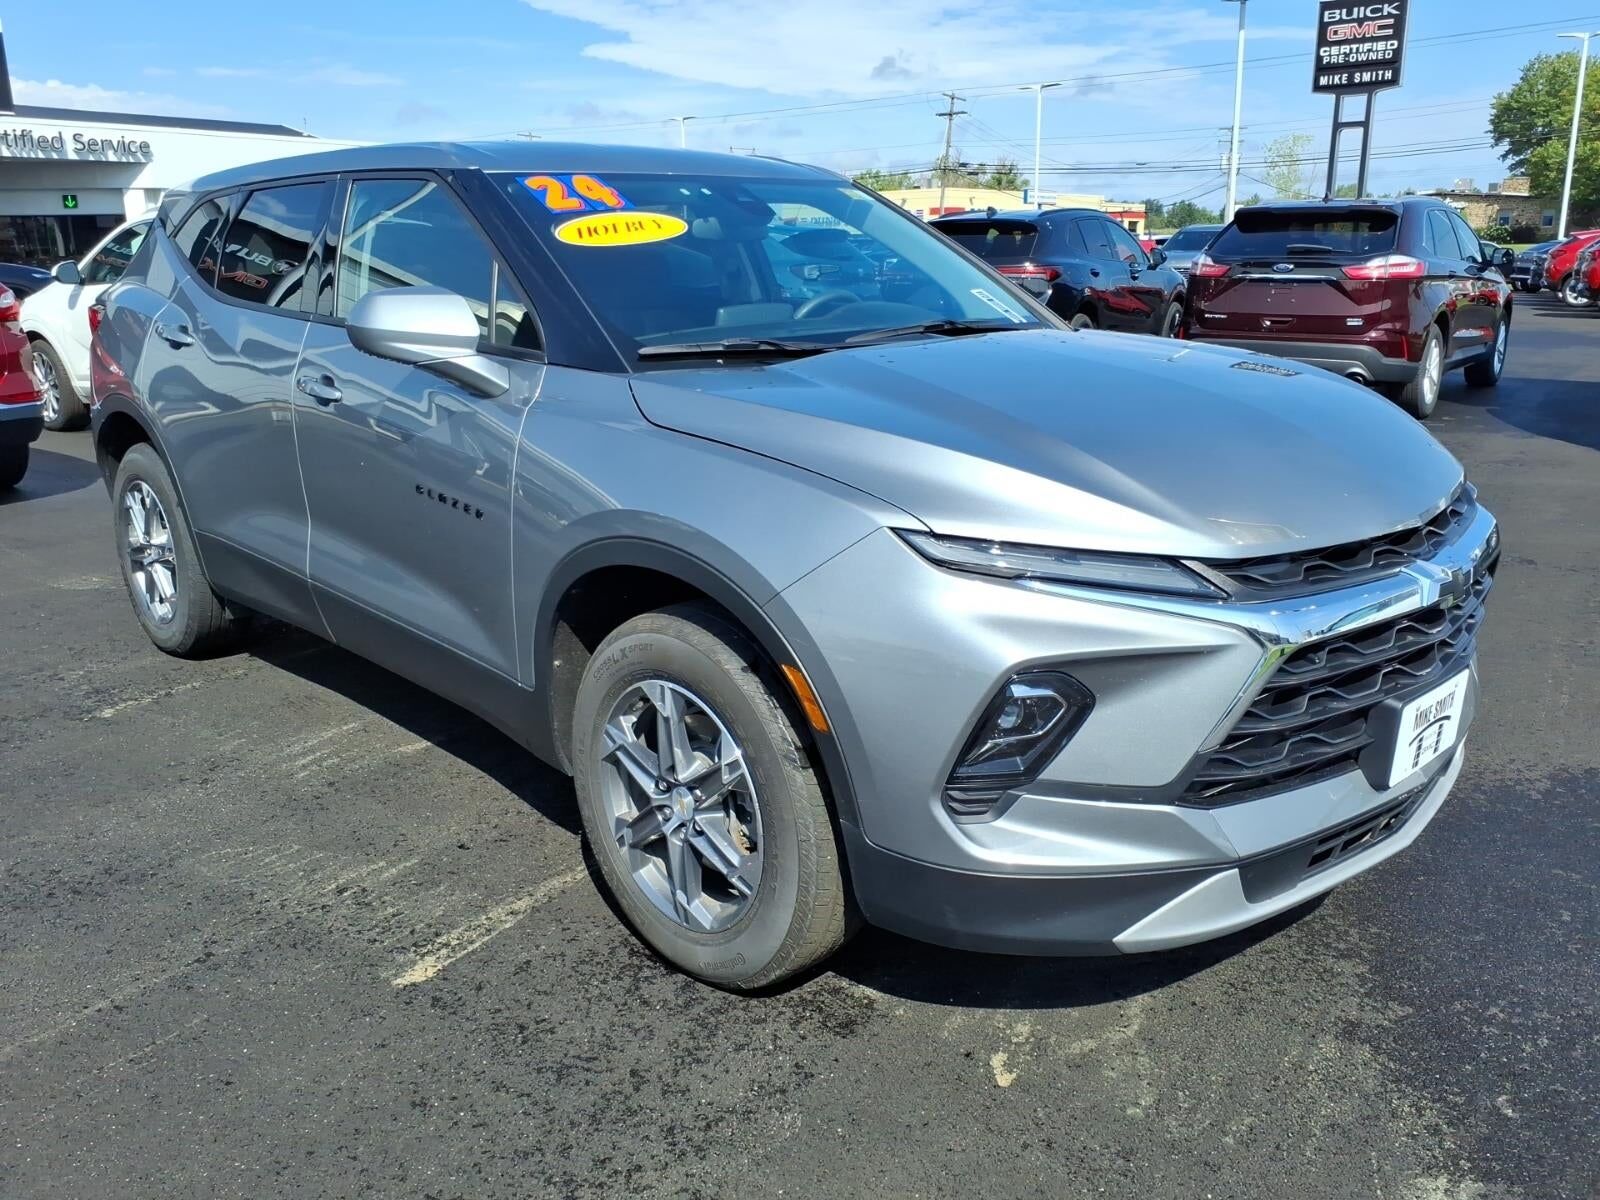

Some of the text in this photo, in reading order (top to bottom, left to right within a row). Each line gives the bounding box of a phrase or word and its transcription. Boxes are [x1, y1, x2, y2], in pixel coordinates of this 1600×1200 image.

[1323, 2, 1400, 22] BUICK
[1327, 19, 1395, 41] GMC
[1320, 40, 1398, 56] CERTIFIED
[1323, 50, 1393, 64] PRE-OWNED
[1320, 70, 1392, 86] MIKE SMITH
[0, 129, 150, 154] tified Service
[524, 175, 625, 211] 24
[1413, 690, 1456, 732] MIKE SMITH
